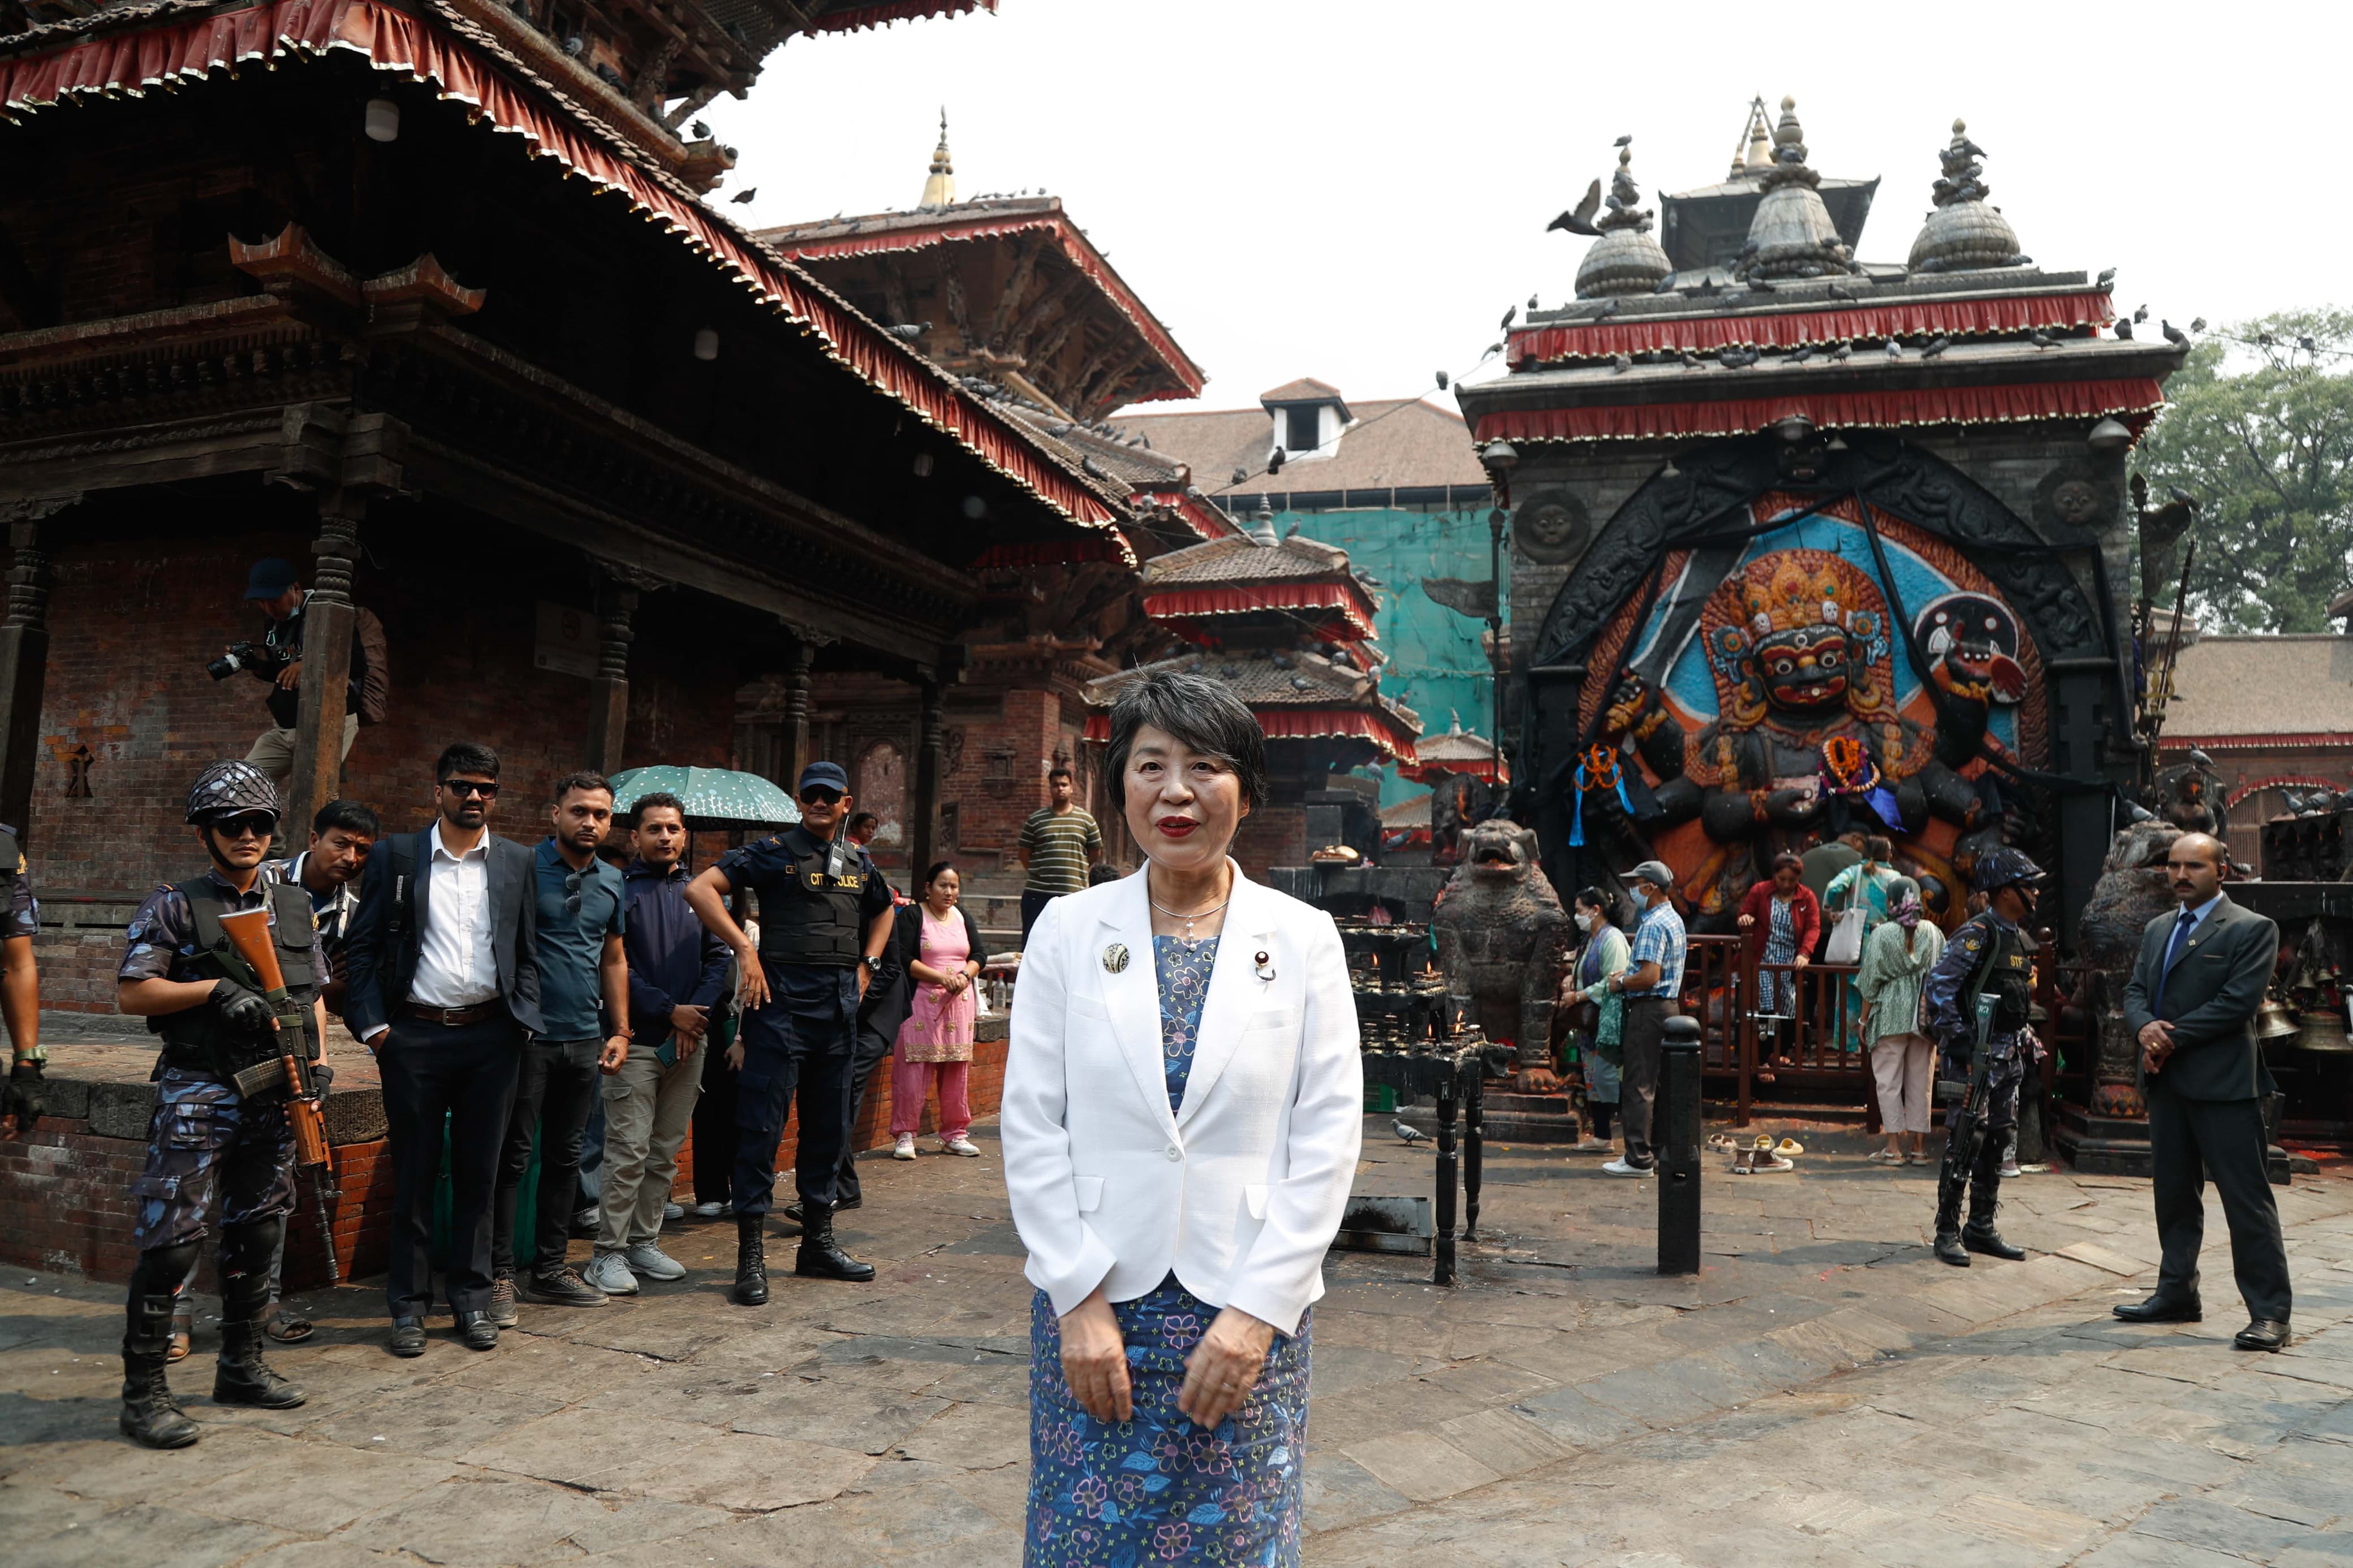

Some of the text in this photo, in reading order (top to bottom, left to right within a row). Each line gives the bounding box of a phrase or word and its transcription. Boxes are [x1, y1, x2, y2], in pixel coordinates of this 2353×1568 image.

[811, 872, 859, 888] CIT OLICE
[2010, 954, 2023, 968] STF
